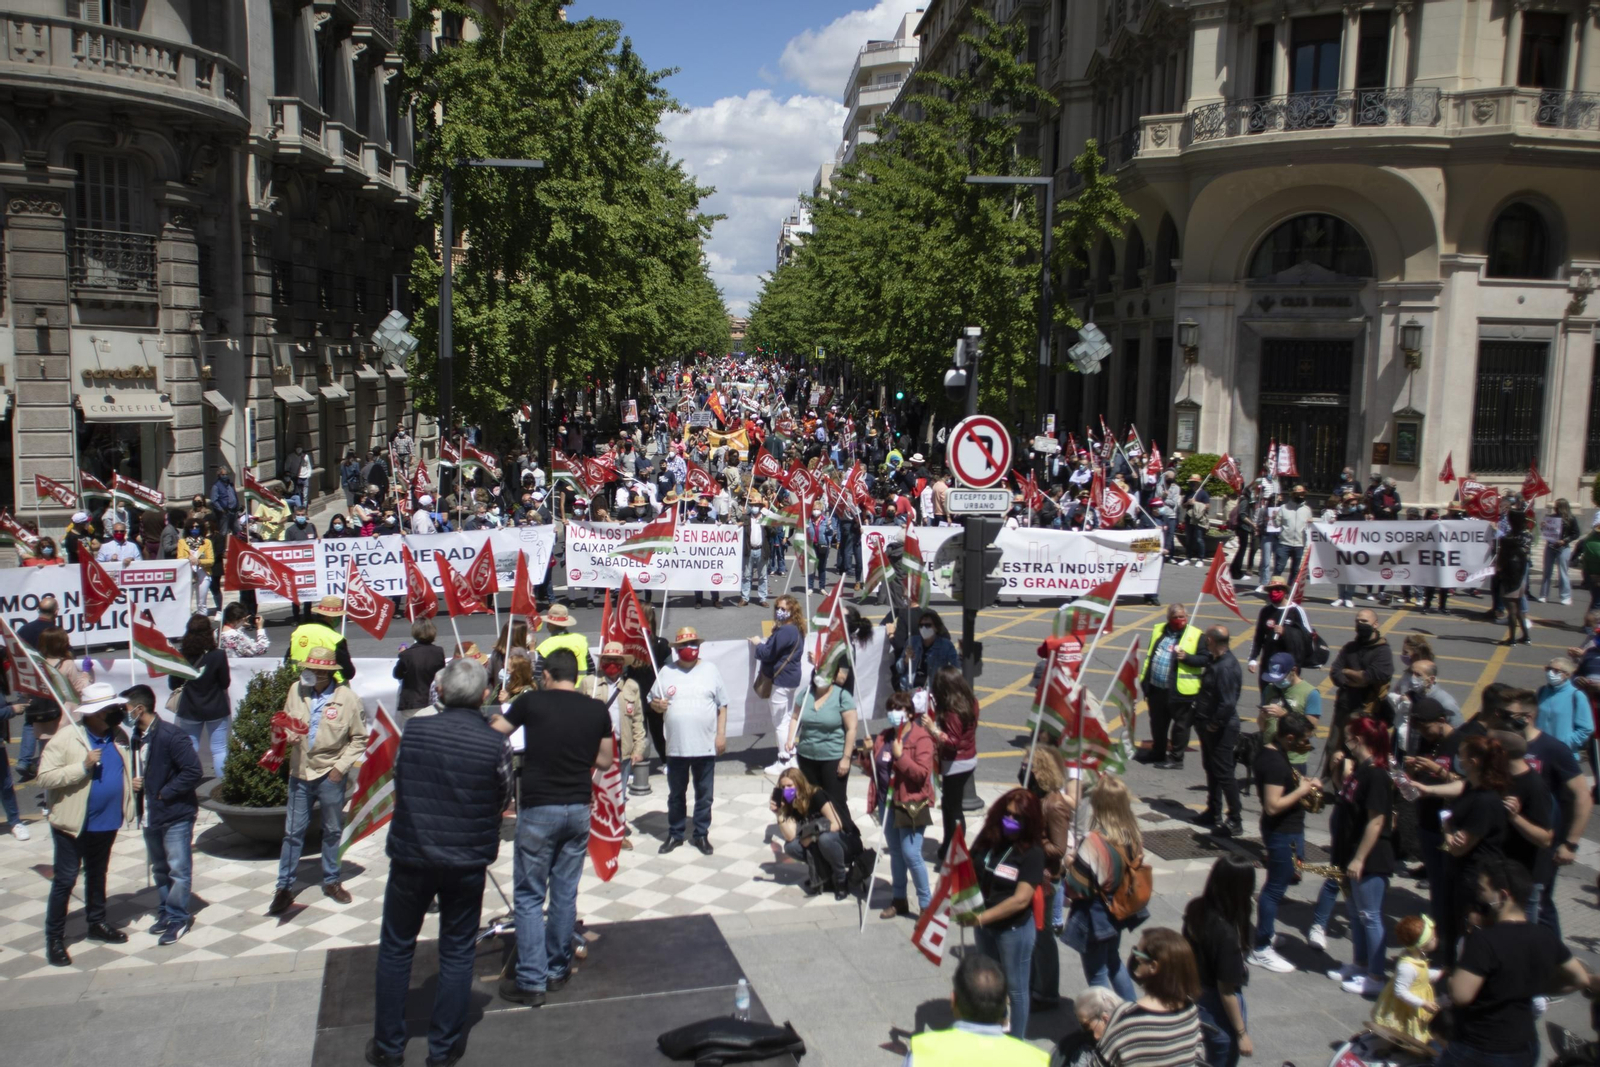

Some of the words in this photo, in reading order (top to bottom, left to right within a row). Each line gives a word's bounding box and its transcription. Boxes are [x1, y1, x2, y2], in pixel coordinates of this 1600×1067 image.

[762, 456, 779, 474] UGT
[570, 526, 586, 539] NO
[589, 527, 597, 540] A
[600, 528, 621, 540] LOS
[683, 530, 698, 543] EN
[701, 530, 739, 543] BANCA
[1312, 531, 1327, 543] EN
[1330, 527, 1359, 545] H&M
[1361, 531, 1381, 543] NO
[1385, 531, 1435, 543] SOBRA
[324, 542, 347, 553] NO
[351, 542, 361, 551] A
[366, 540, 385, 550] LA
[689, 546, 736, 556] UNICAJA
[656, 559, 724, 569] SANTANDER
[1336, 550, 1370, 566] NO
[1379, 550, 1410, 566] AL
[1419, 550, 1461, 566] ERE
[1003, 562, 1054, 573] ESTRA
[1060, 562, 1143, 574] INDUSTRA!
[124, 572, 164, 582] CCOO
[327, 570, 345, 580] EN
